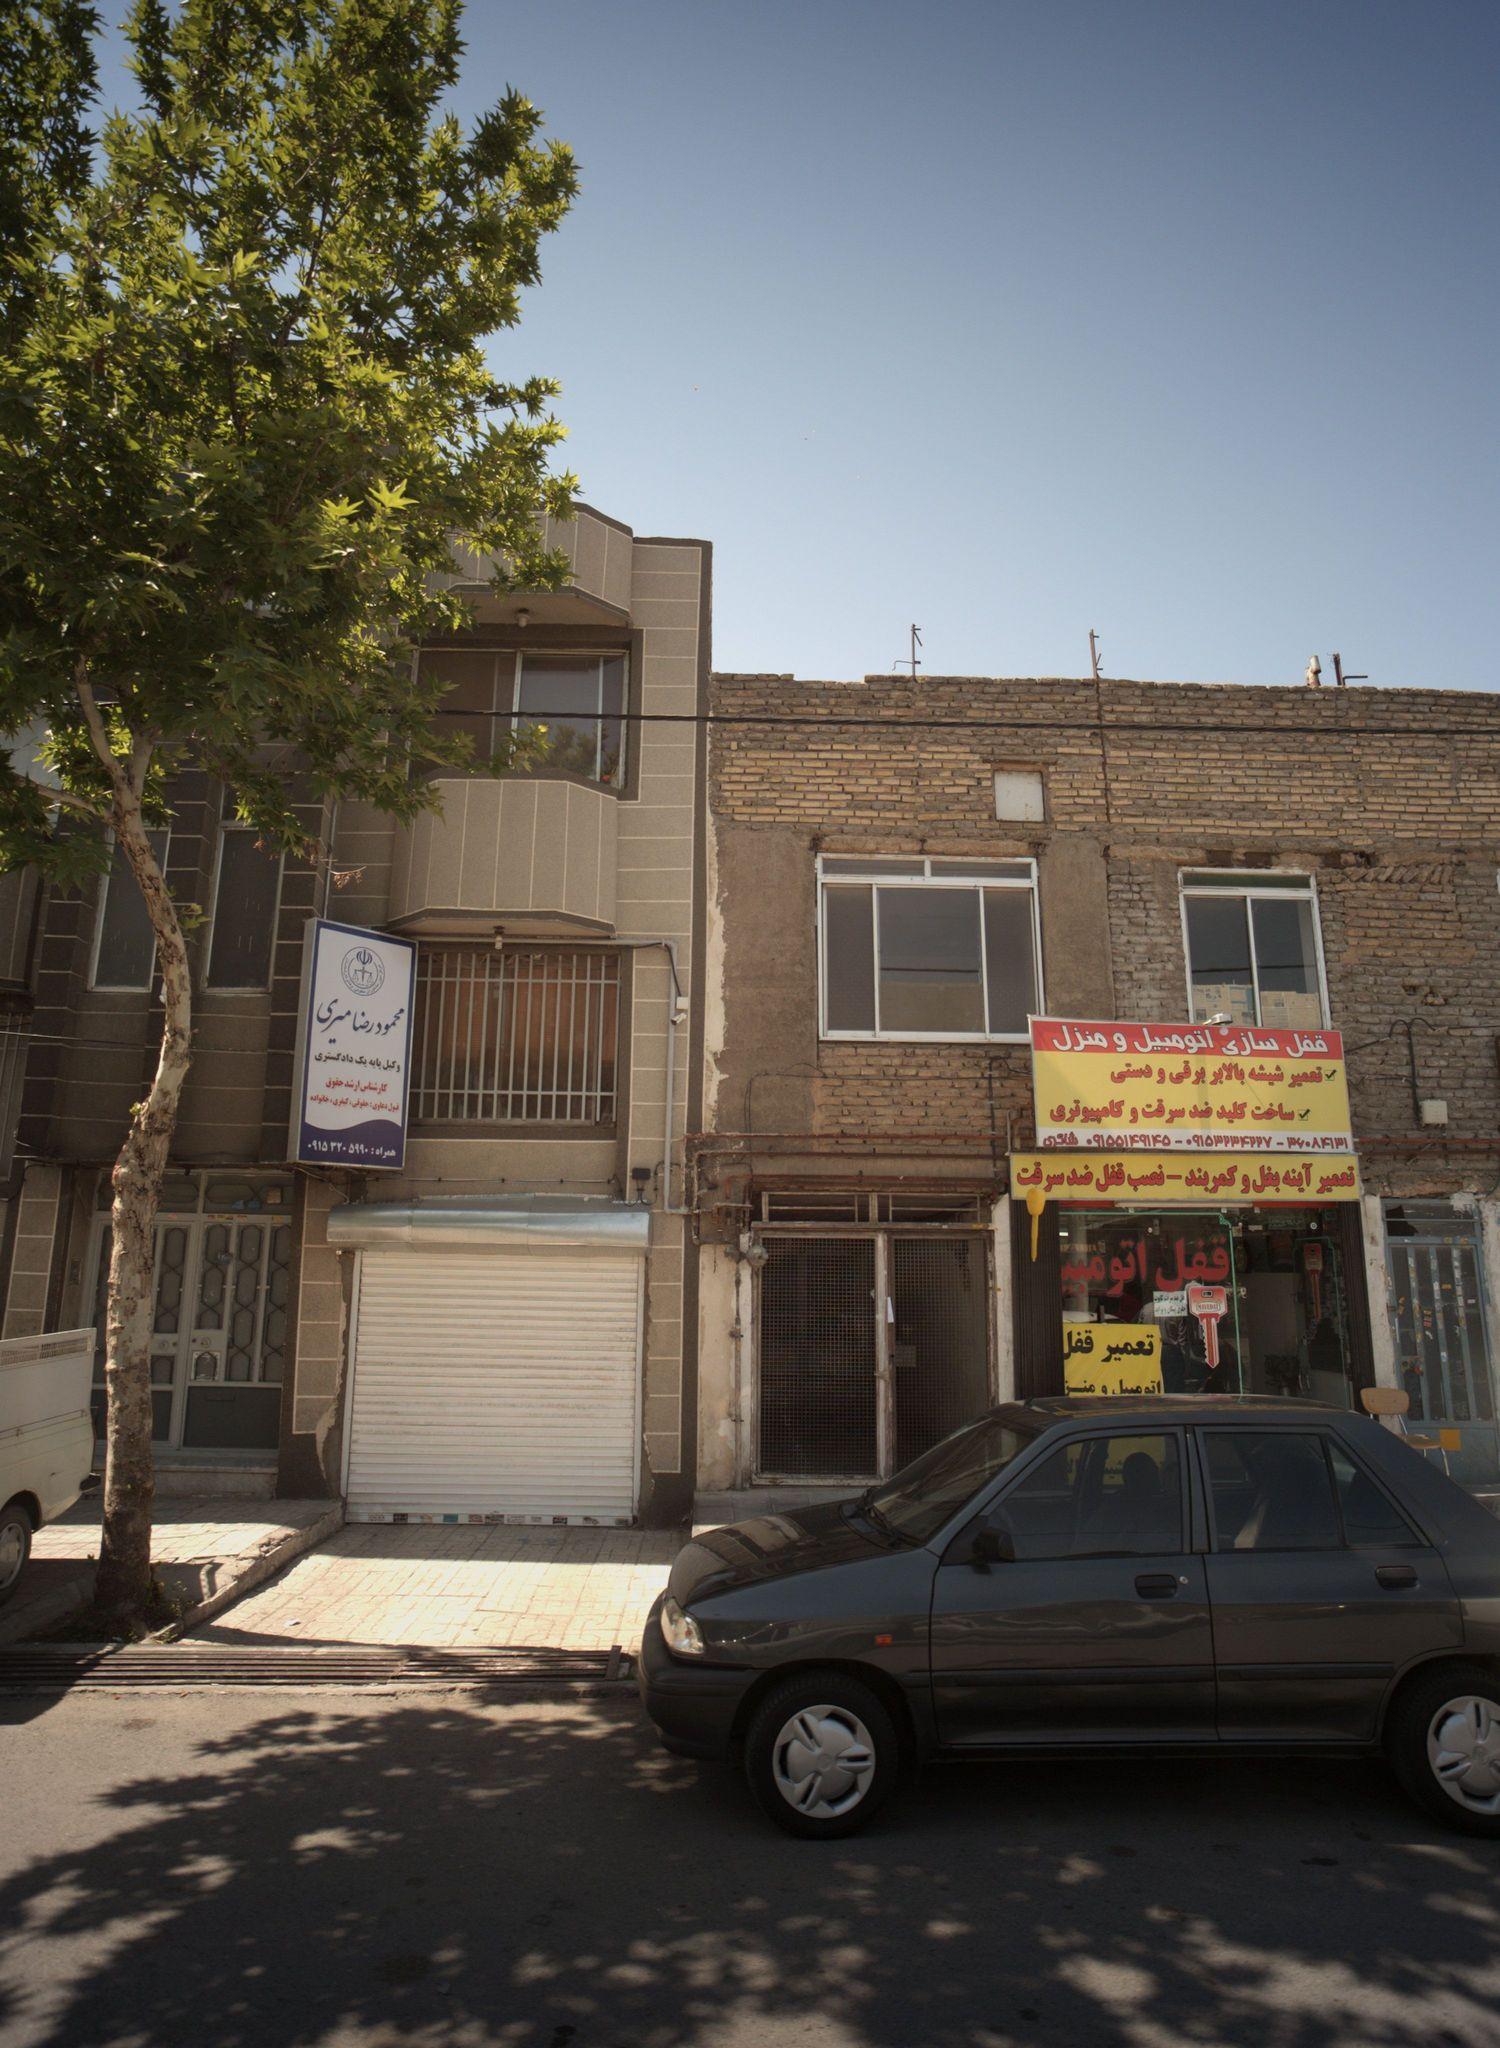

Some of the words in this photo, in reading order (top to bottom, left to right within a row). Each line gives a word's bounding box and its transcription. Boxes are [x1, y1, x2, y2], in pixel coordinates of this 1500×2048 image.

[1052, 1024, 1109, 1052] منزل
[1112, 1032, 1128, 1053] و
[1133, 1027, 1214, 1054] اتومبیل
[1221, 1031, 1280, 1056] سازی
[1285, 1033, 1329, 1058] قفل
[314, 1052, 354, 1063] دادگستری
[354, 1055, 367, 1068] یک
[368, 1058, 382, 1070] پایه
[382, 1060, 401, 1073] وکیل
[325, 1077, 344, 1089] حقوق
[1110, 1063, 1153, 1084] دستی
[1156, 1067, 1166, 1085] و
[1168, 1060, 1206, 1085] برقی
[1209, 1062, 1245, 1086] بالابر
[1248, 1064, 1284, 1087] شیشه
[1288, 1066, 1323, 1088] تعمیر
[344, 1080, 360, 1092] ارشد
[360, 1081, 388, 1095] کارشناس
[1050, 1099, 1125, 1124] کامپیوتری
[1129, 1106, 1139, 1123] و
[1141, 1098, 1185, 1123] سرقت
[1188, 1101, 1213, 1119] ضد
[1216, 1101, 1248, 1124] کلید
[1251, 1102, 1295, 1121] ساخت
[1016, 1161, 1065, 1192] سرقت
[1067, 1164, 1094, 1186] ضد
[1095, 1162, 1125, 1192] قفل
[1127, 1163, 1165, 1192] نصب
[1184, 1165, 1238, 1194] کمربند
[1240, 1174, 1250, 1194] و
[1252, 1164, 1281, 1194] بغل
[1282, 1162, 1313, 1193] آینه
[1316, 1165, 1356, 1194] تعمیر
[1061, 1239, 1147, 1298] اتومبی
[1156, 1235, 1231, 1292] قفل
[1063, 1329, 1094, 1360] قفل
[1100, 1334, 1154, 1363] تعمیر
[1064, 1380, 1096, 1396] منز
[1101, 1384, 1108, 1395] و
